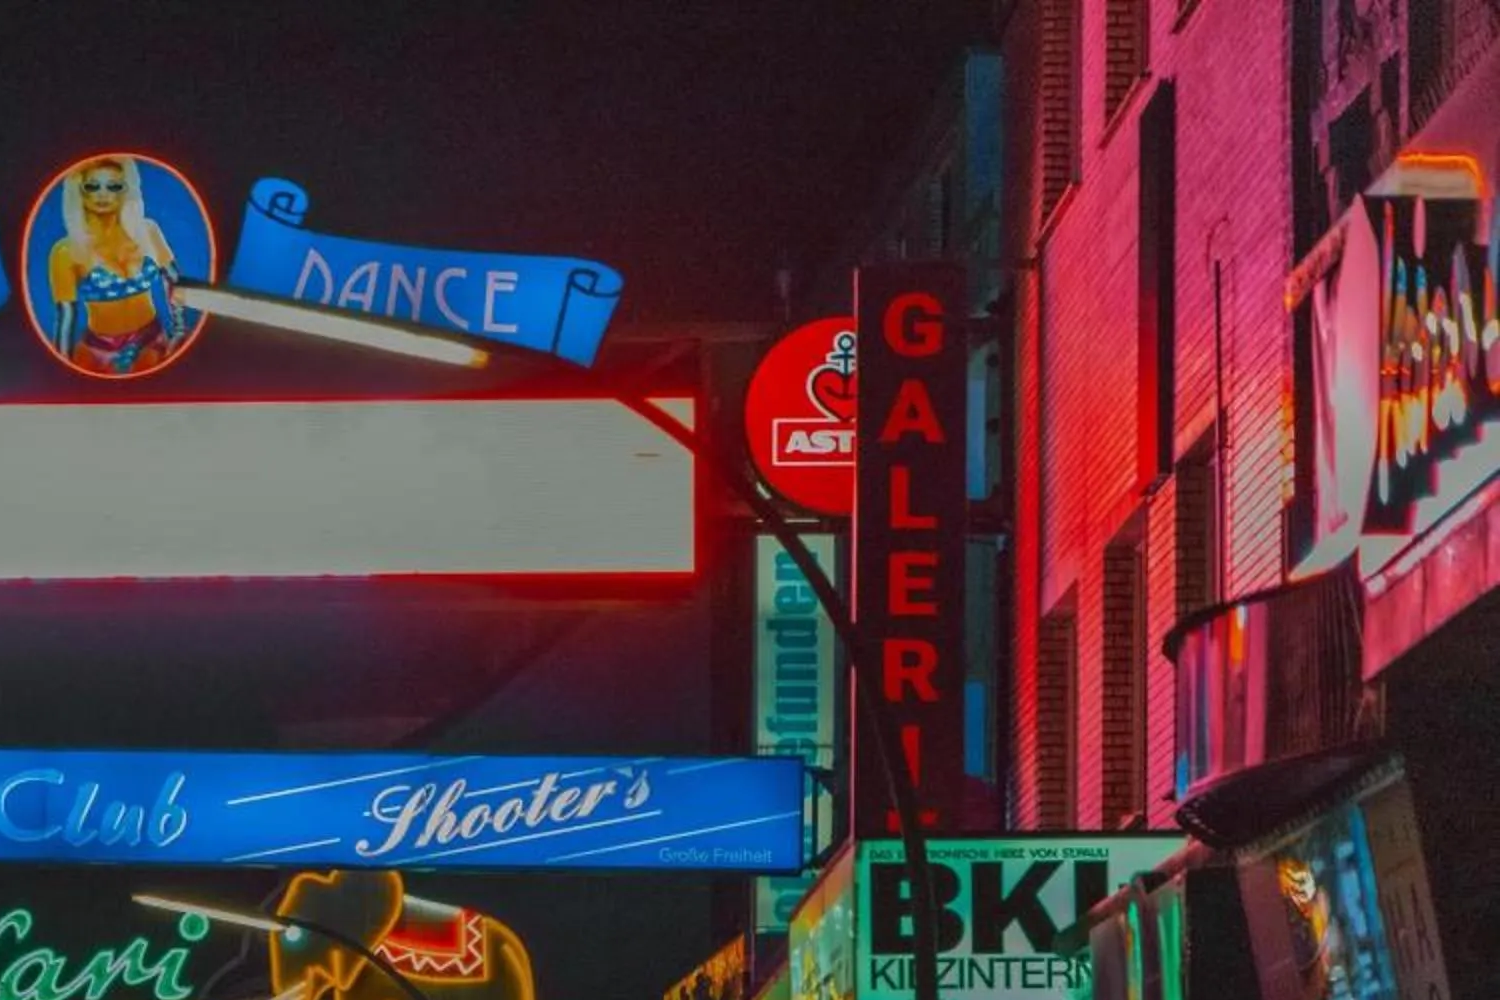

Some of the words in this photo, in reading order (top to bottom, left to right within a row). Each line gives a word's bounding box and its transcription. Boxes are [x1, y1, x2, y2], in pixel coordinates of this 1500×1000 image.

[293, 246, 519, 333] DANCE
[879, 292, 946, 832] GALERI
[355, 767, 652, 857] Shooter's
